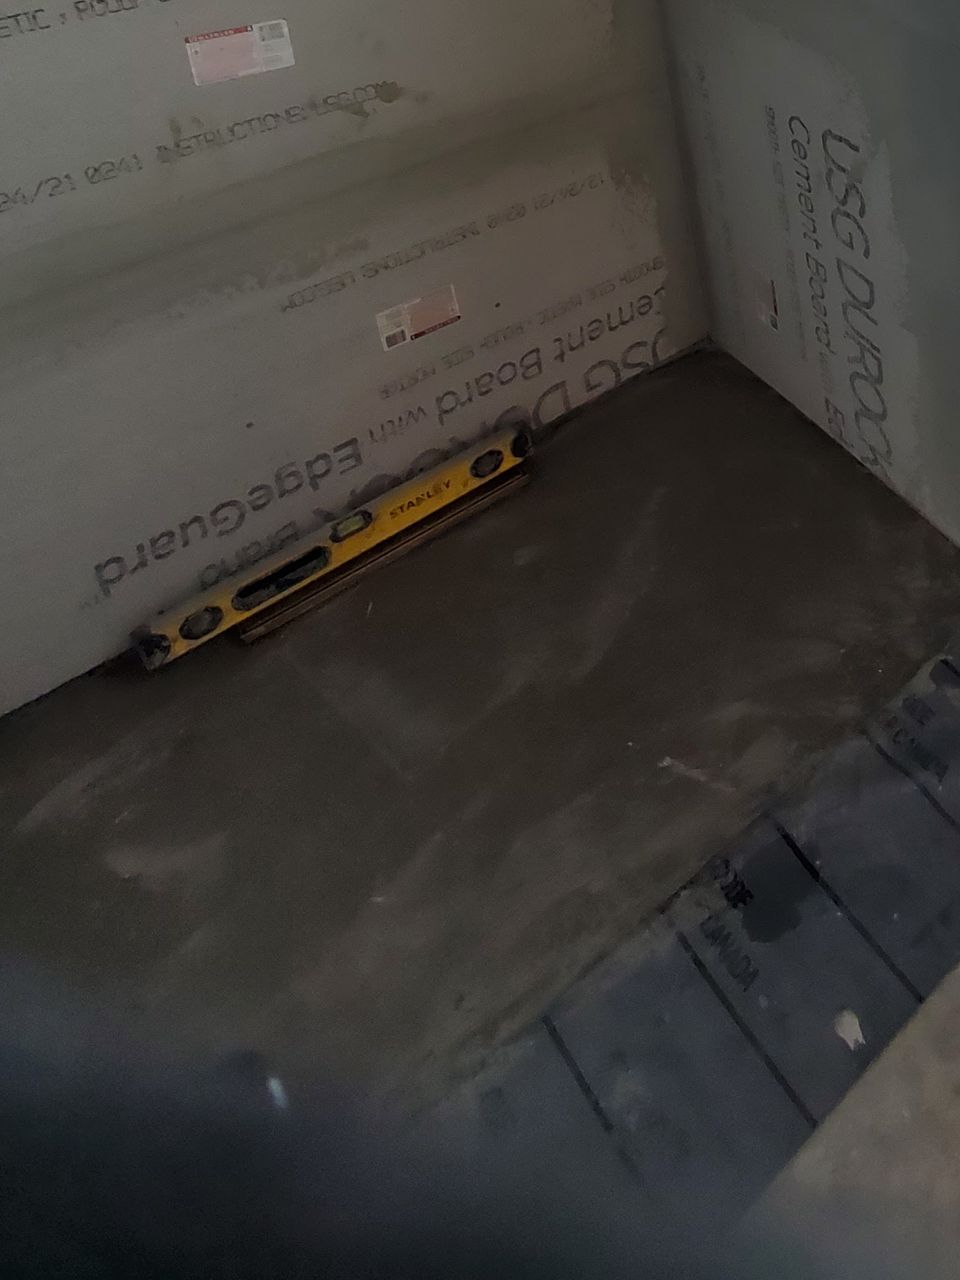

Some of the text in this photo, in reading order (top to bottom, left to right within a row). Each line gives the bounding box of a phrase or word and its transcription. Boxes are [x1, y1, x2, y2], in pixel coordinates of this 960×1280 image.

[788, 115, 823, 252] Cement
[824, 128, 872, 260] USG
[804, 253, 838, 355] Board
[365, 400, 430, 442] with
[435, 347, 544, 426] Board
[95, 437, 364, 596] EdgeGuard
[388, 478, 453, 518] STANLEY
